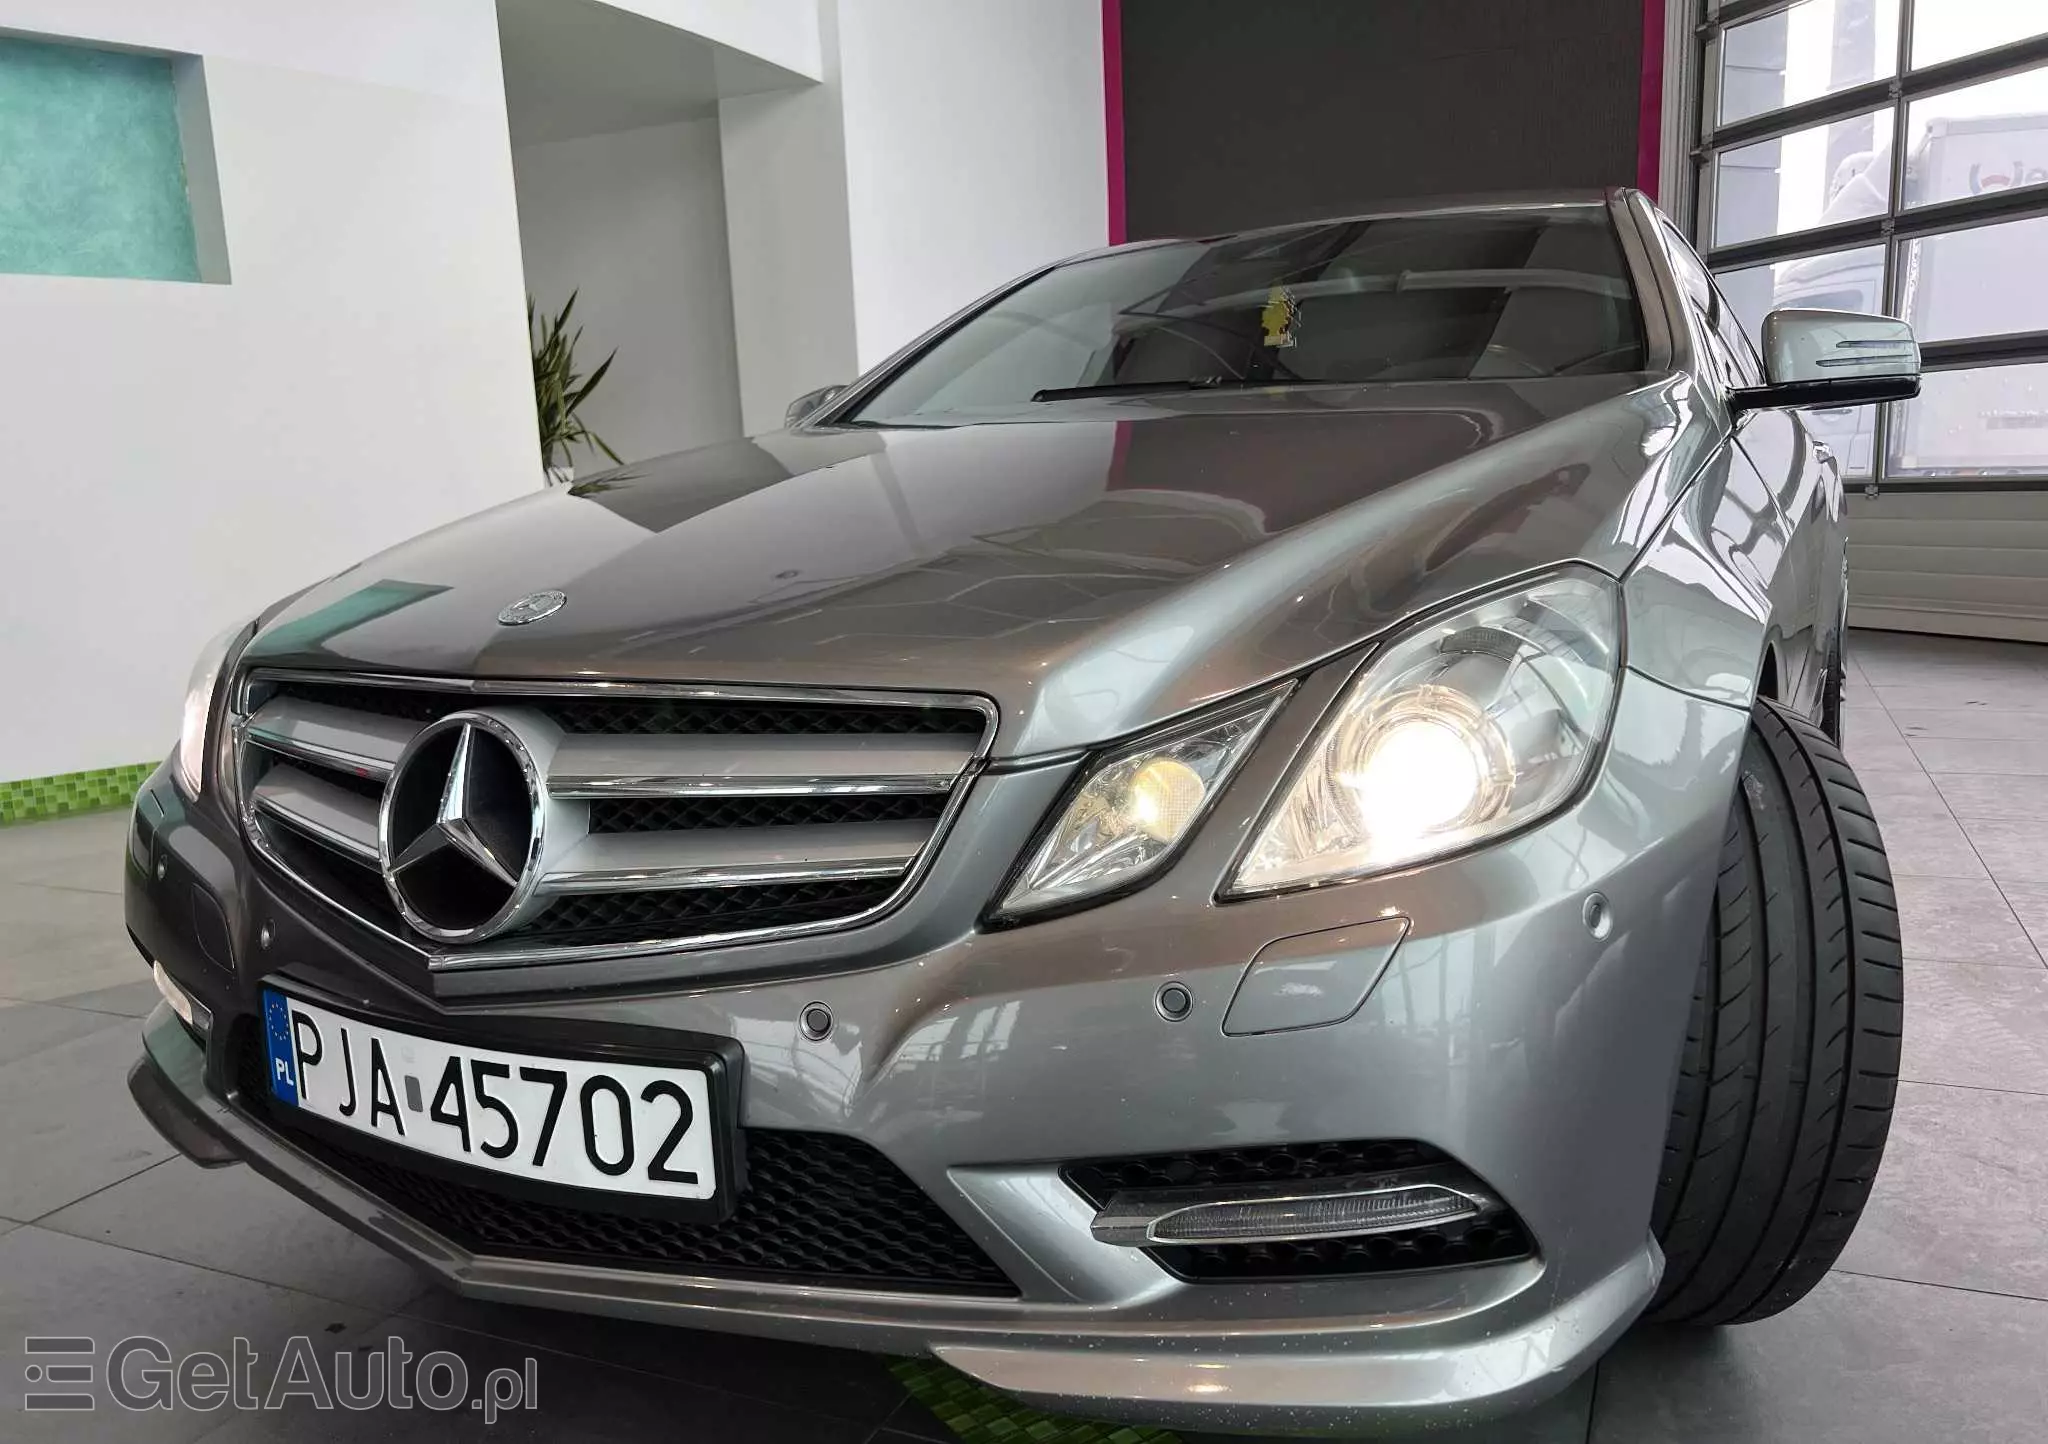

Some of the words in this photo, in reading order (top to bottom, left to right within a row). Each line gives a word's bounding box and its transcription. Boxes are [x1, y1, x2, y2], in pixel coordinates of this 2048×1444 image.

[275, 1057, 294, 1086] PL
[292, 1009, 405, 1136] PJA
[430, 1055, 699, 1185] 45702
